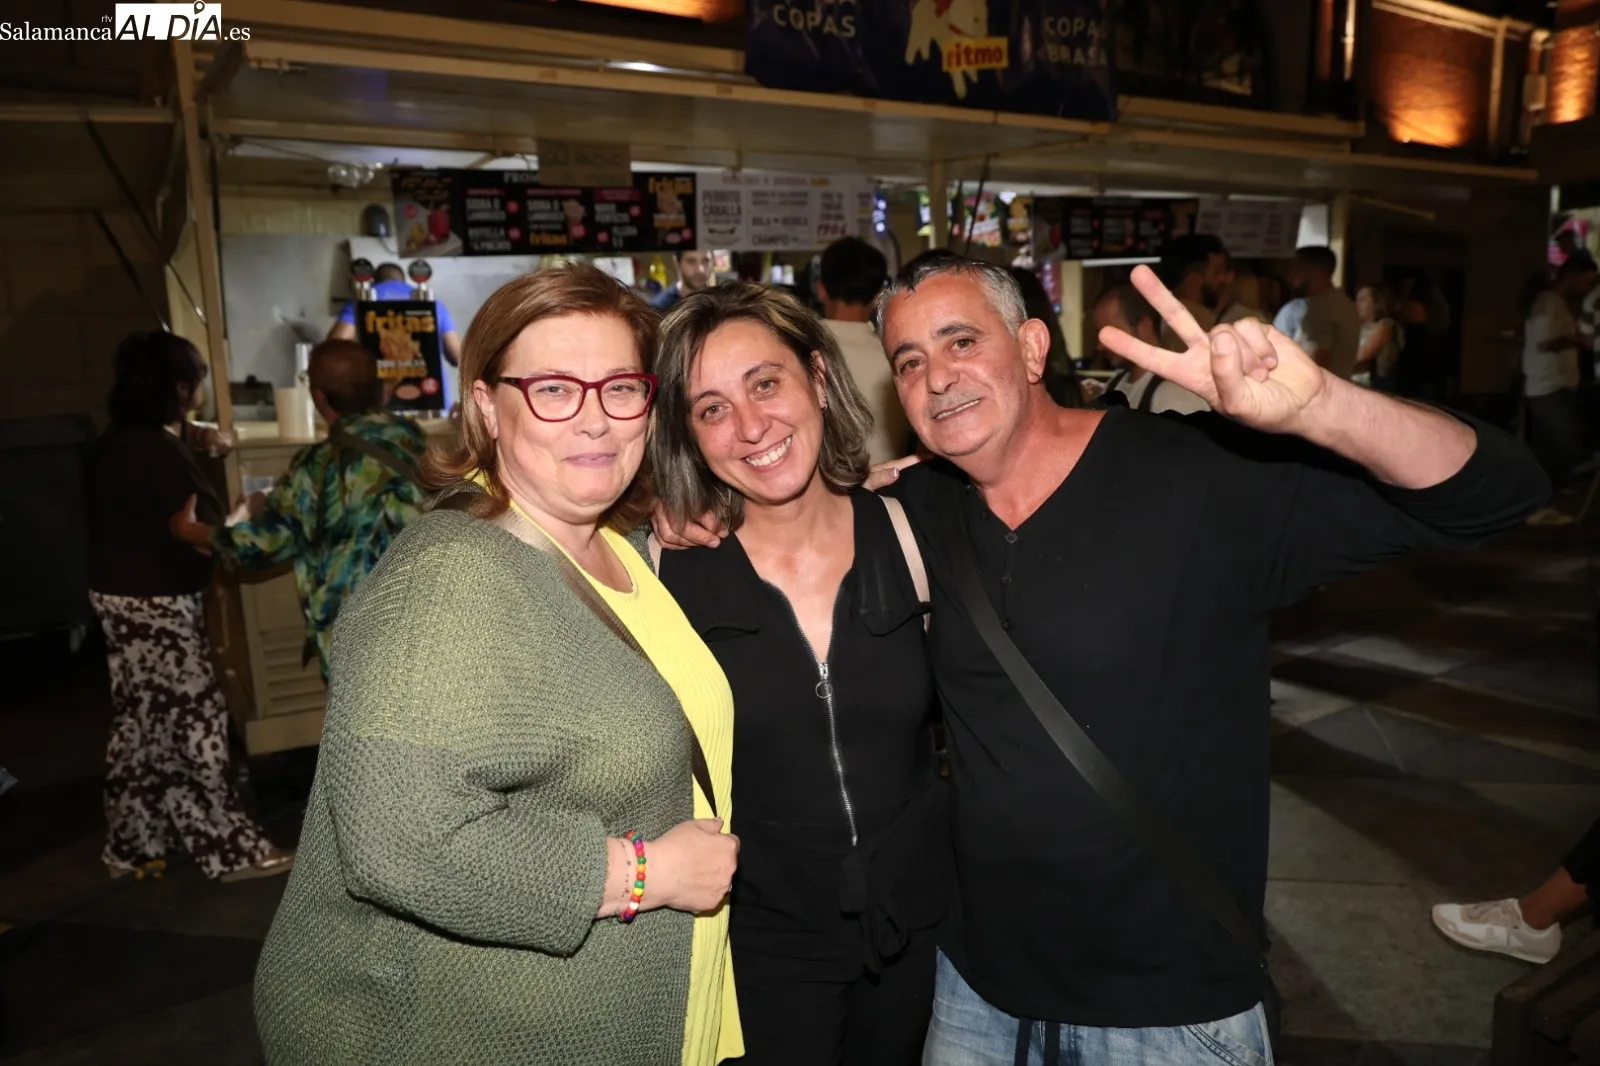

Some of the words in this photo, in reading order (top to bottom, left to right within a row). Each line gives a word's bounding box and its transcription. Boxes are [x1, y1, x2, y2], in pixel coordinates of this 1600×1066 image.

[772, 3, 857, 39] COPAS
[1043, 16, 1108, 40] COPAS
[946, 43, 1004, 68] ritmo
[365, 309, 435, 334] fritas
